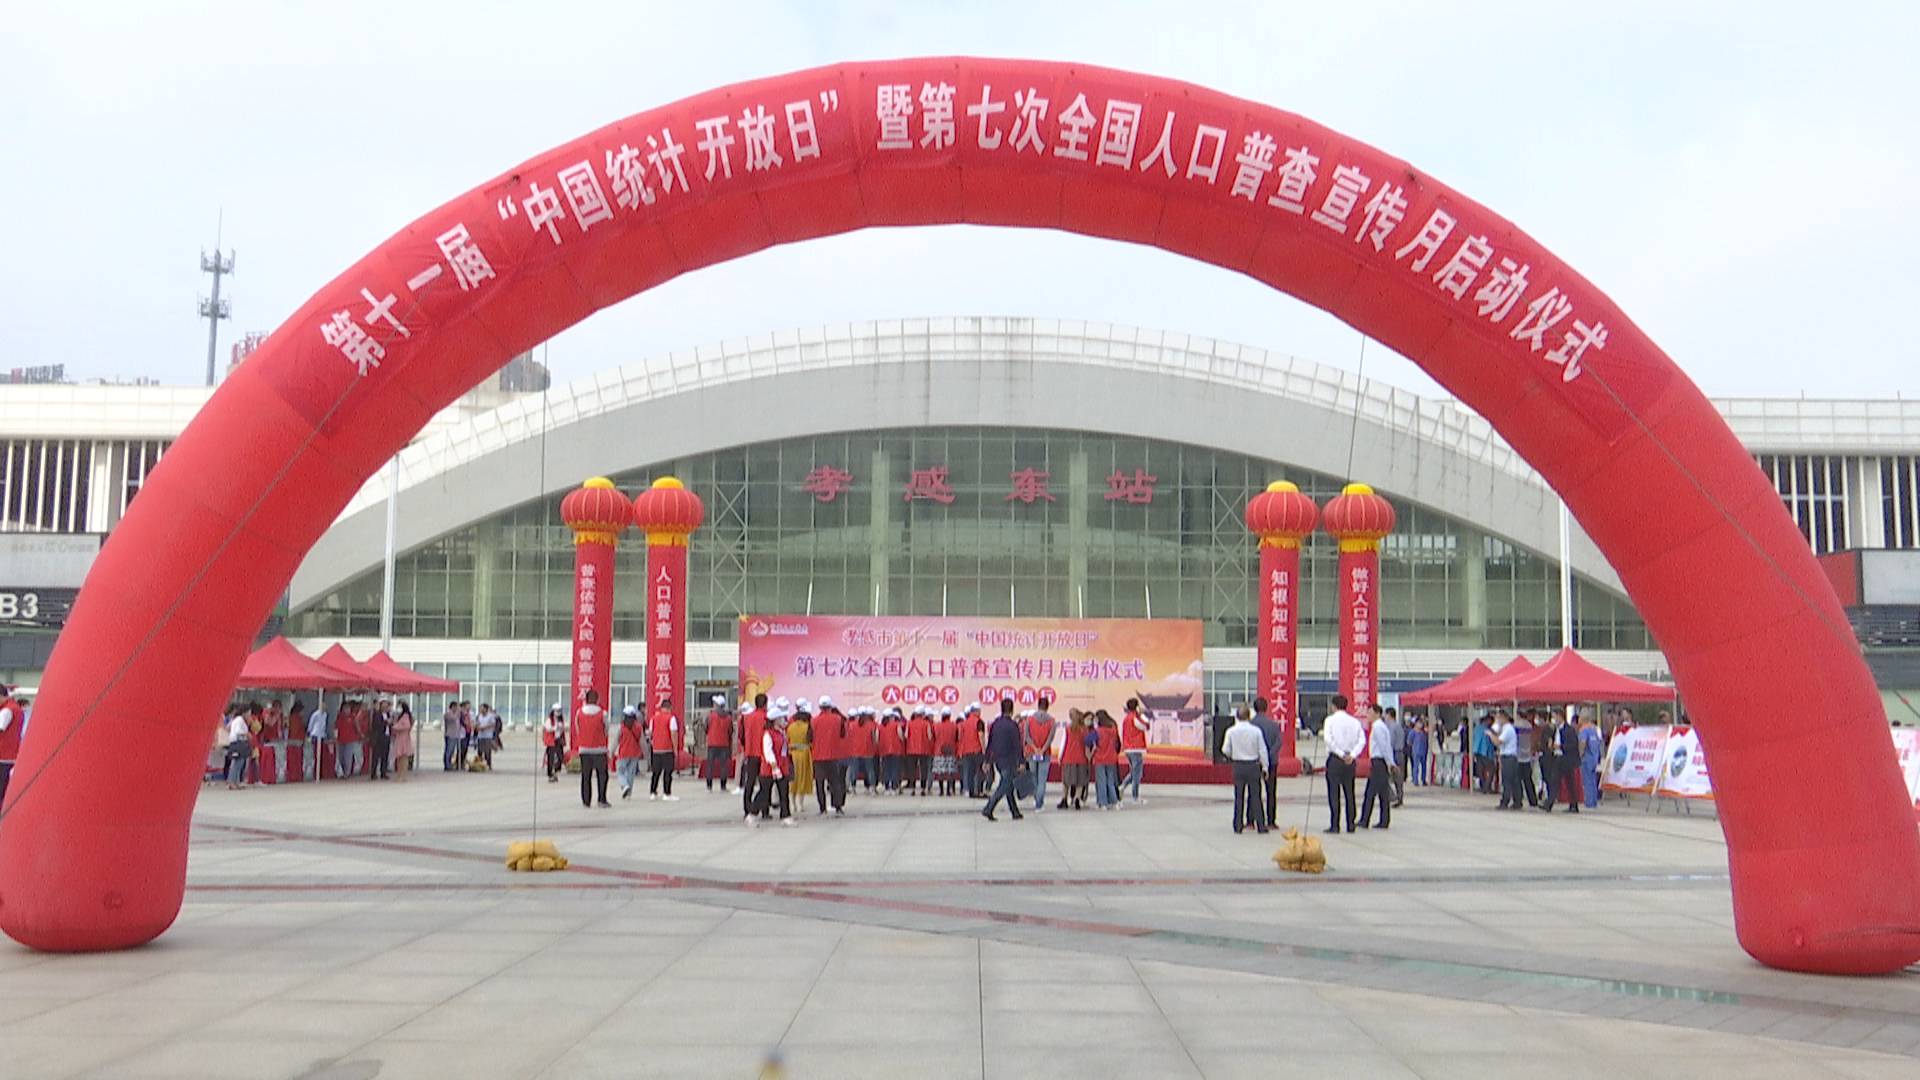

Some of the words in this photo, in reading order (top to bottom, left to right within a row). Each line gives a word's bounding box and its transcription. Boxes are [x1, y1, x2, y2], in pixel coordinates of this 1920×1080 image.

[655, 565, 672, 639] 人口普查
[796, 656, 1144, 680] 第七次全国人口普查宣传月启动仪式
[883, 685, 958, 703] 大国点名
